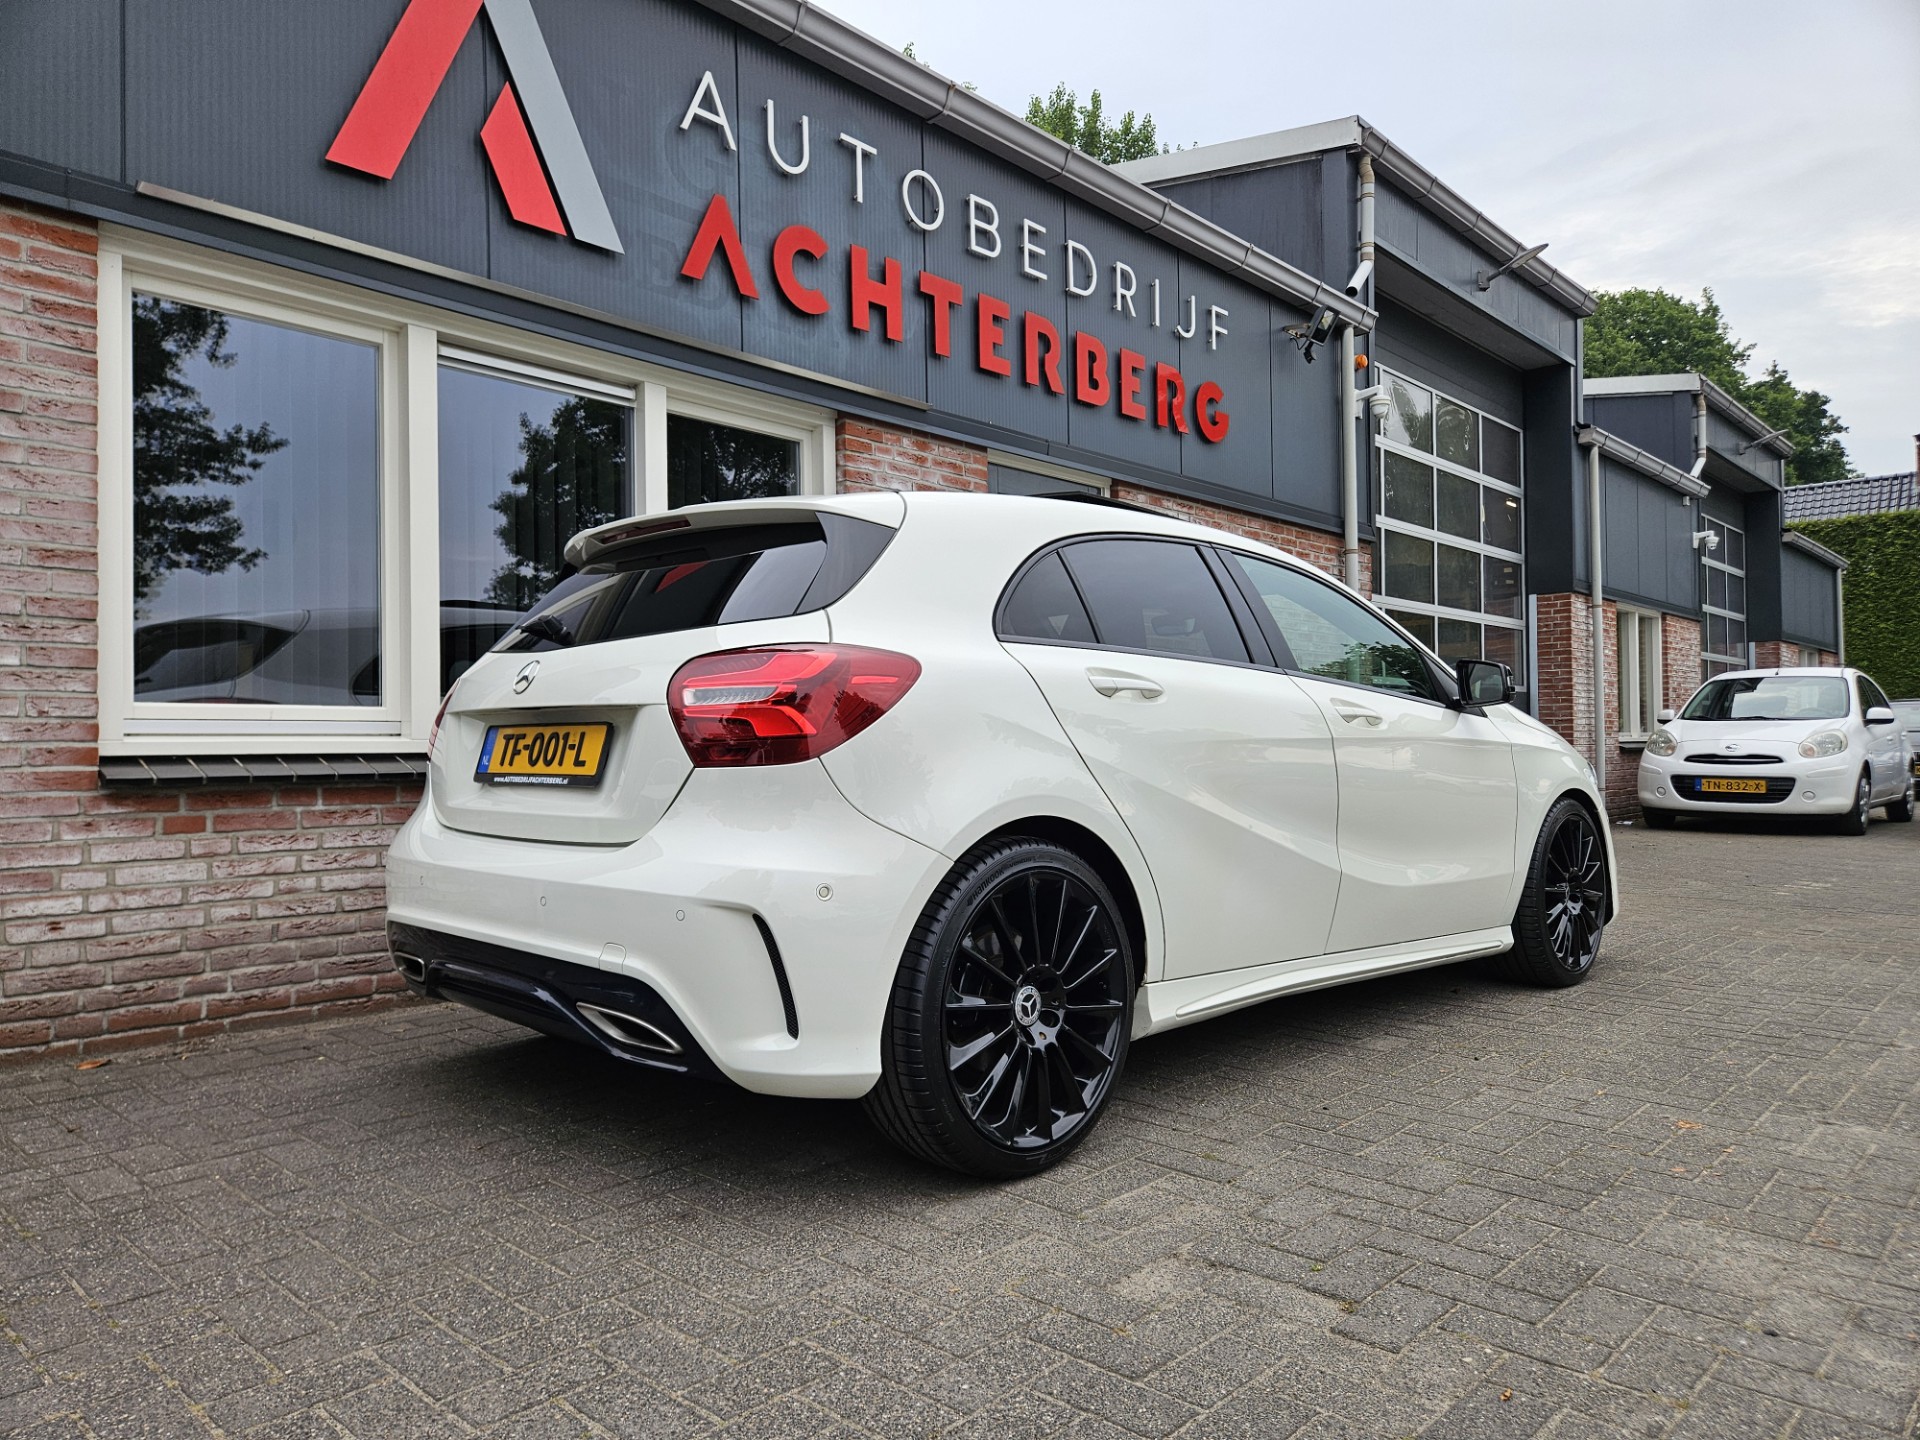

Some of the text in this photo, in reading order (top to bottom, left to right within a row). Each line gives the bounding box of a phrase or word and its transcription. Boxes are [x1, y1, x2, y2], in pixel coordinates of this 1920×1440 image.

[680, 71, 1230, 350] AUTOBEDRIJF
[681, 193, 1231, 443] ACHTERBERG
[499, 731, 586, 767] TF-001-L
[1706, 780, 1761, 791] TN-832-X
